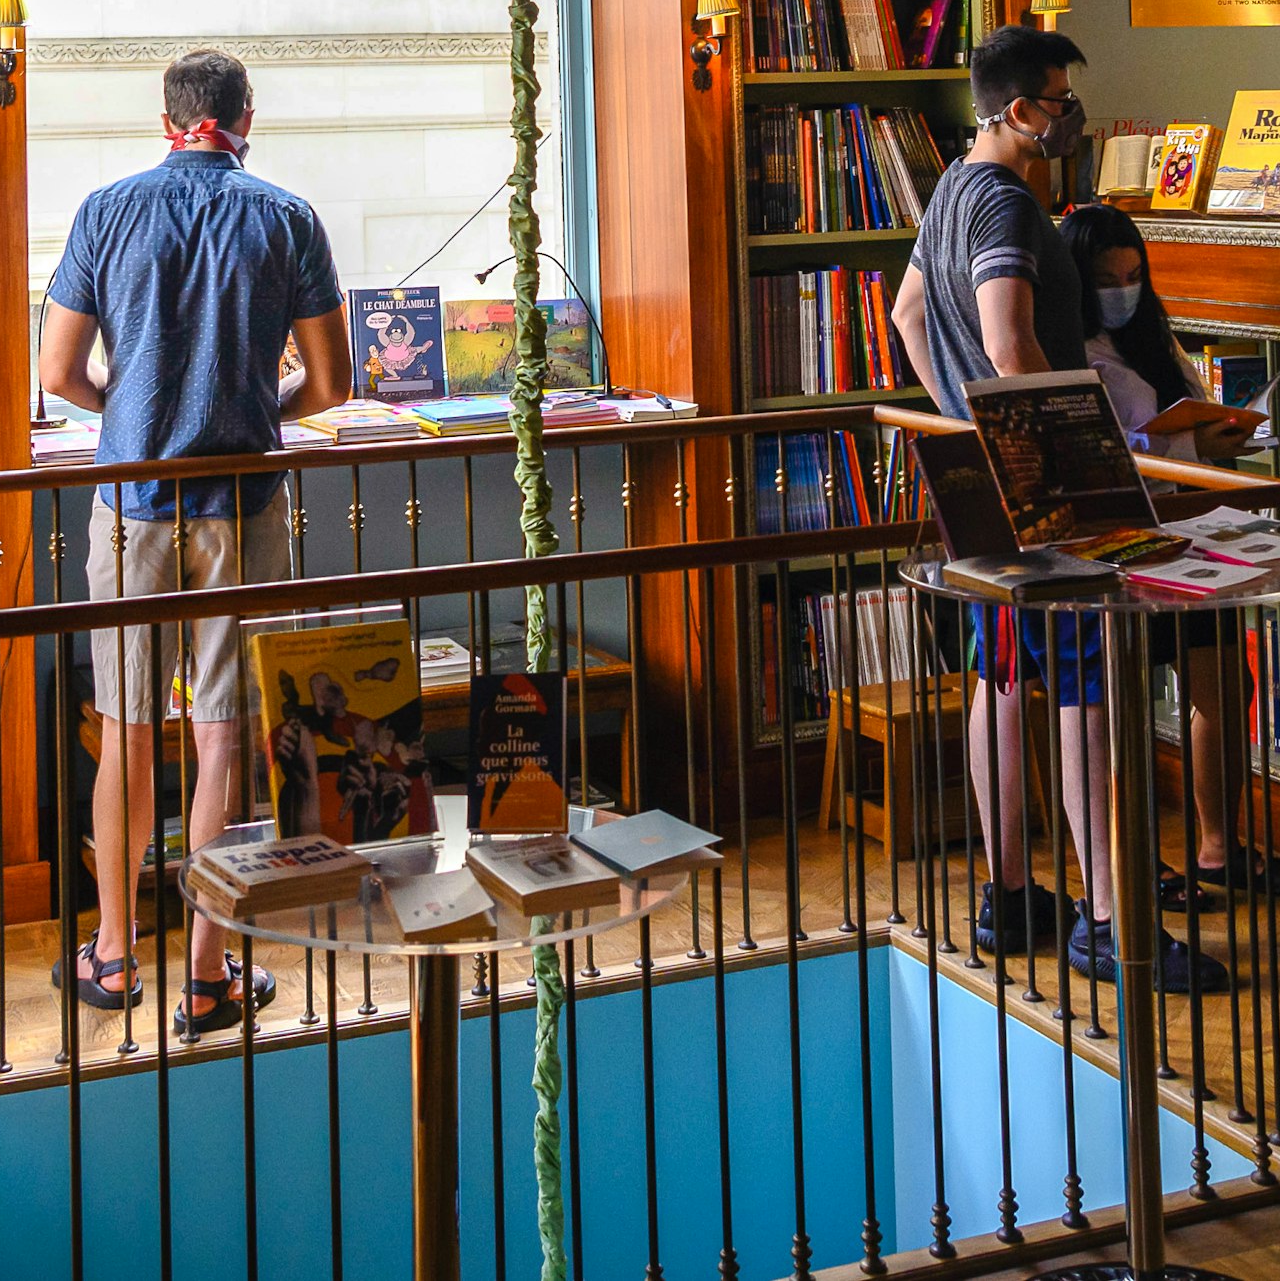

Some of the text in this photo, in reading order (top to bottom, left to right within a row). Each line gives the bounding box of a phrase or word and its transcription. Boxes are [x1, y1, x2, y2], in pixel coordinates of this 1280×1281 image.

[363, 302, 373, 311] LE
[373, 301, 394, 310] CHAT
[495, 693, 537, 704] Amanda
[495, 703, 537, 714] Gorman
[507, 725, 524, 738] La
[489, 739, 541, 753] colline
[481, 754, 549, 769] que nous
[476, 769, 554, 787] gravissons
[223, 840, 330, 866] L'appel
[237, 859, 270, 874] du
[297, 848, 347, 868] juin
